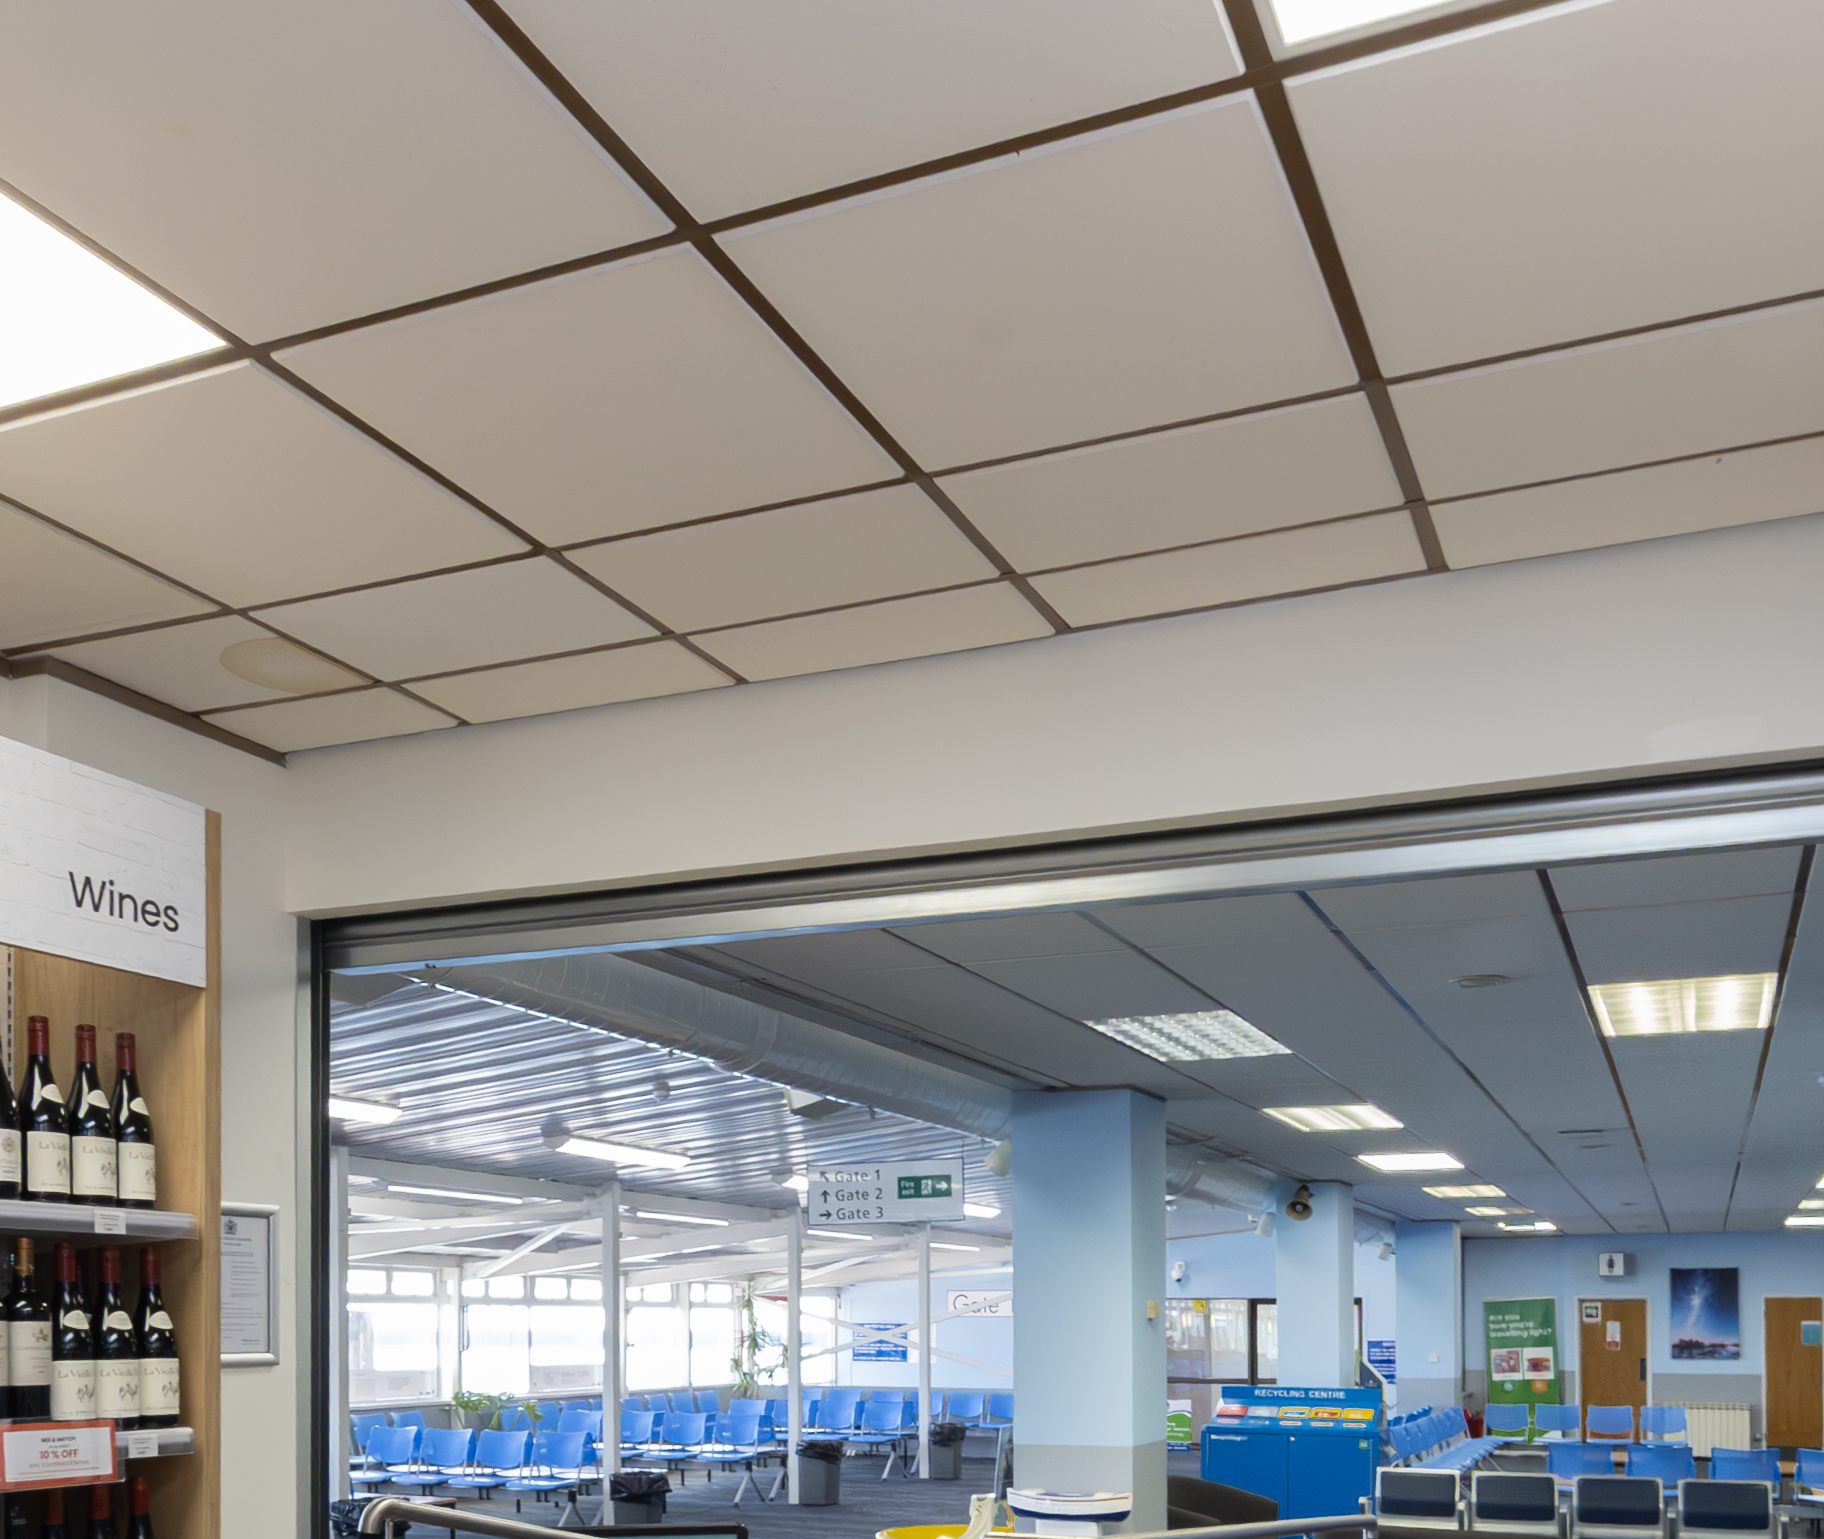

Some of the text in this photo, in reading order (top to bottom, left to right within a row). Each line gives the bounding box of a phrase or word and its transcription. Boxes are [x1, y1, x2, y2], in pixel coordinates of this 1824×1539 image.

[68, 871, 180, 934] Wines
[834, 1170, 880, 1184] Gate 1
[835, 1188, 883, 1201] Gate 2
[836, 1207, 884, 1220] Gate 3
[1255, 1389, 1346, 1399] RECYCLING CENTRE
